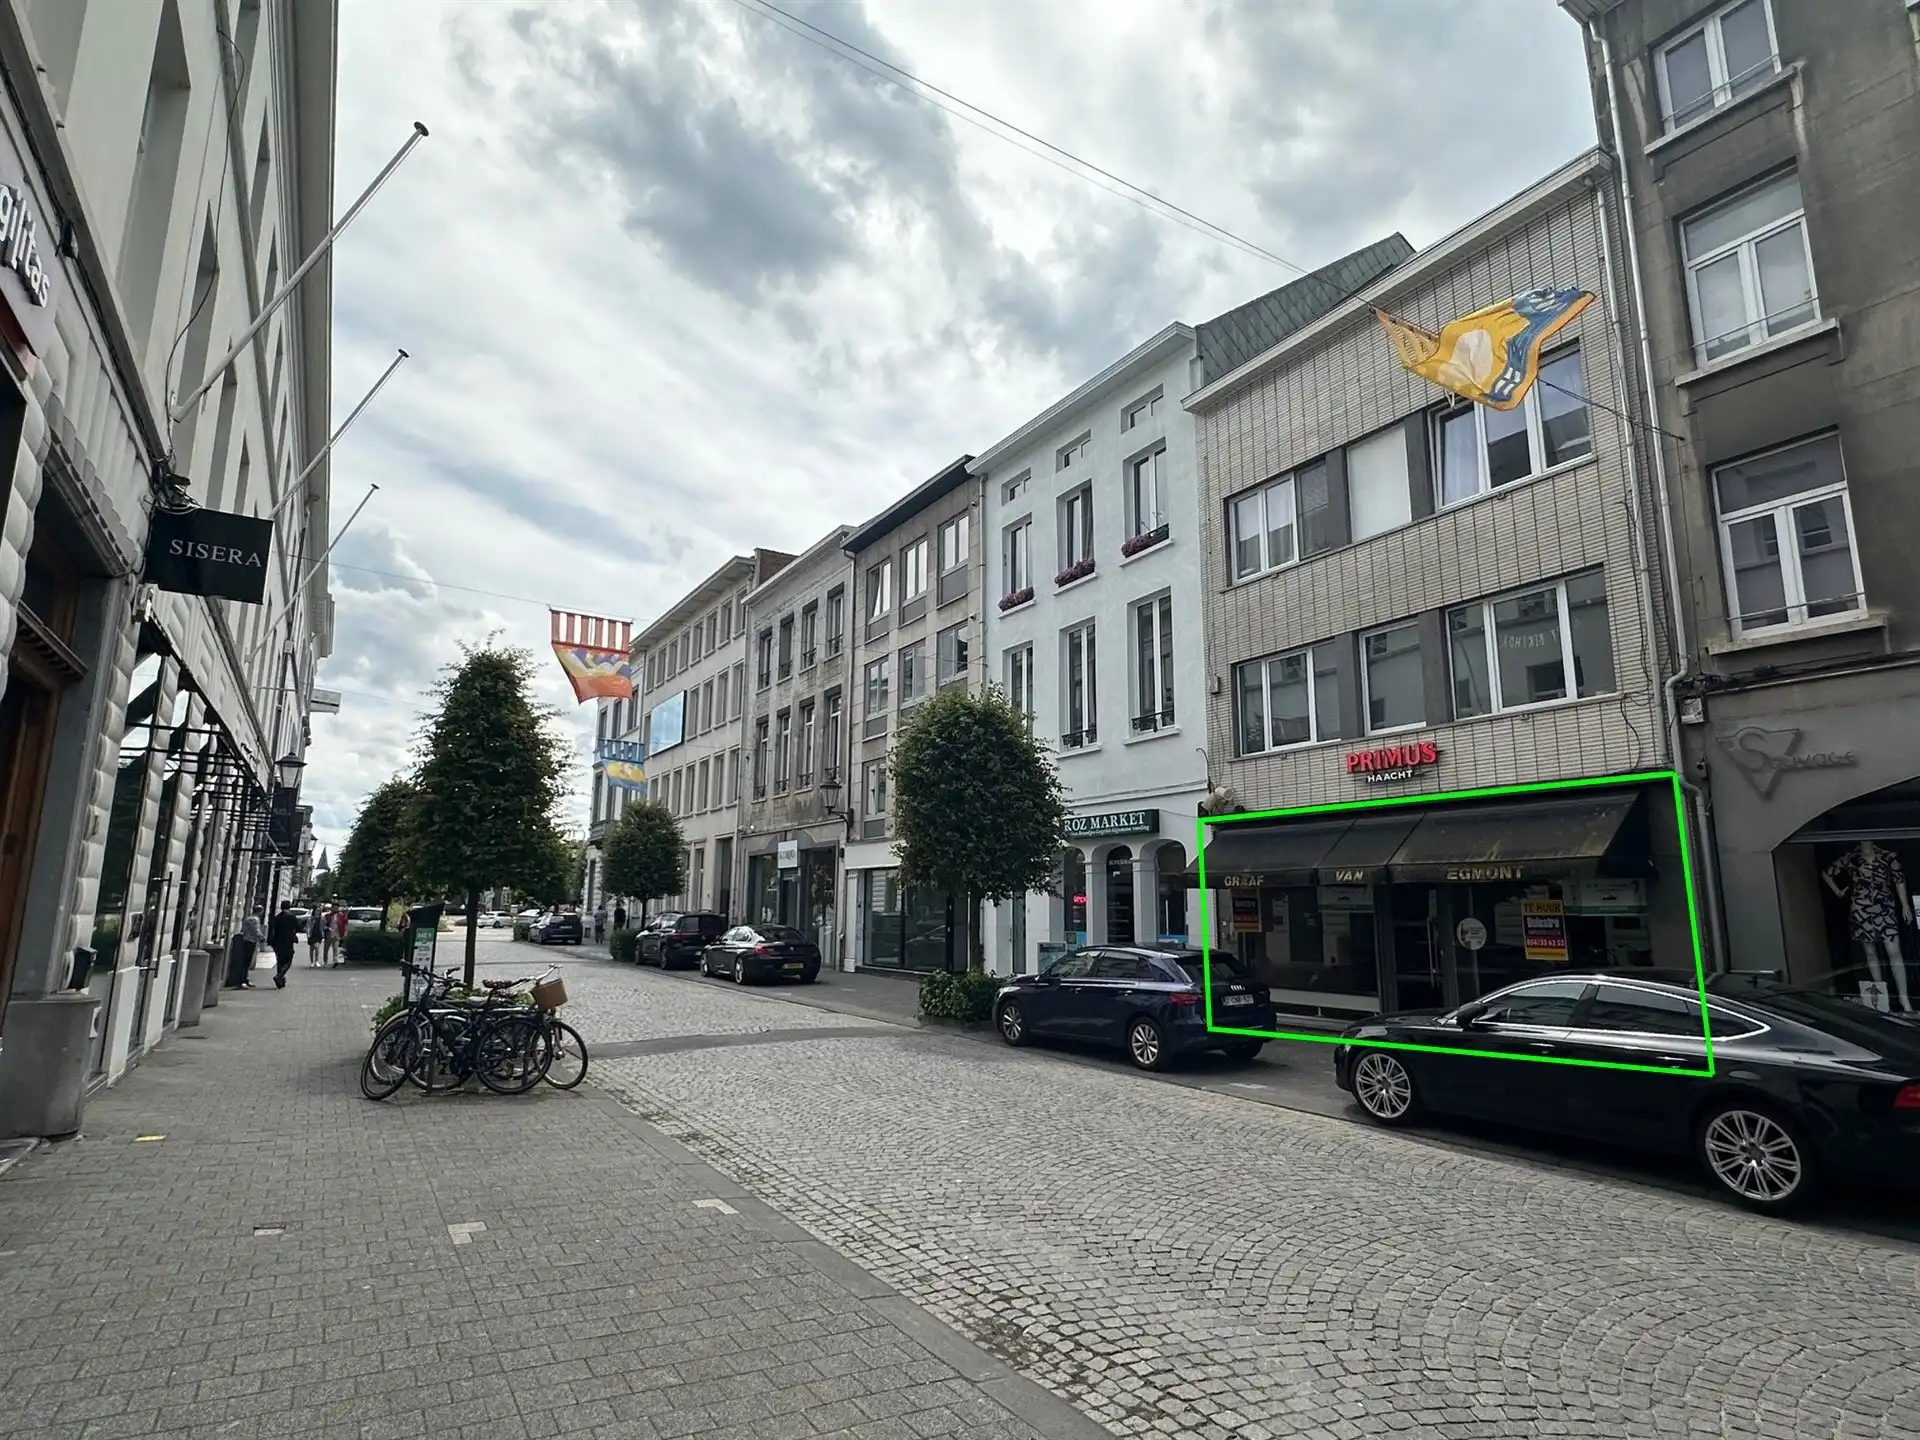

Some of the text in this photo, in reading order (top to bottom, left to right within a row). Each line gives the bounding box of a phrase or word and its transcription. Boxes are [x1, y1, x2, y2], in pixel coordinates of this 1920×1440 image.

[169, 539, 262, 568] SISERA
[1345, 741, 1437, 774] PRIMUS
[1367, 770, 1413, 783] HAACHT
[1090, 812, 1146, 829] MARKET
[1335, 870, 1364, 881] VAN
[1446, 865, 1525, 880] EGMONT
[1536, 901, 1562, 913] HUUR
